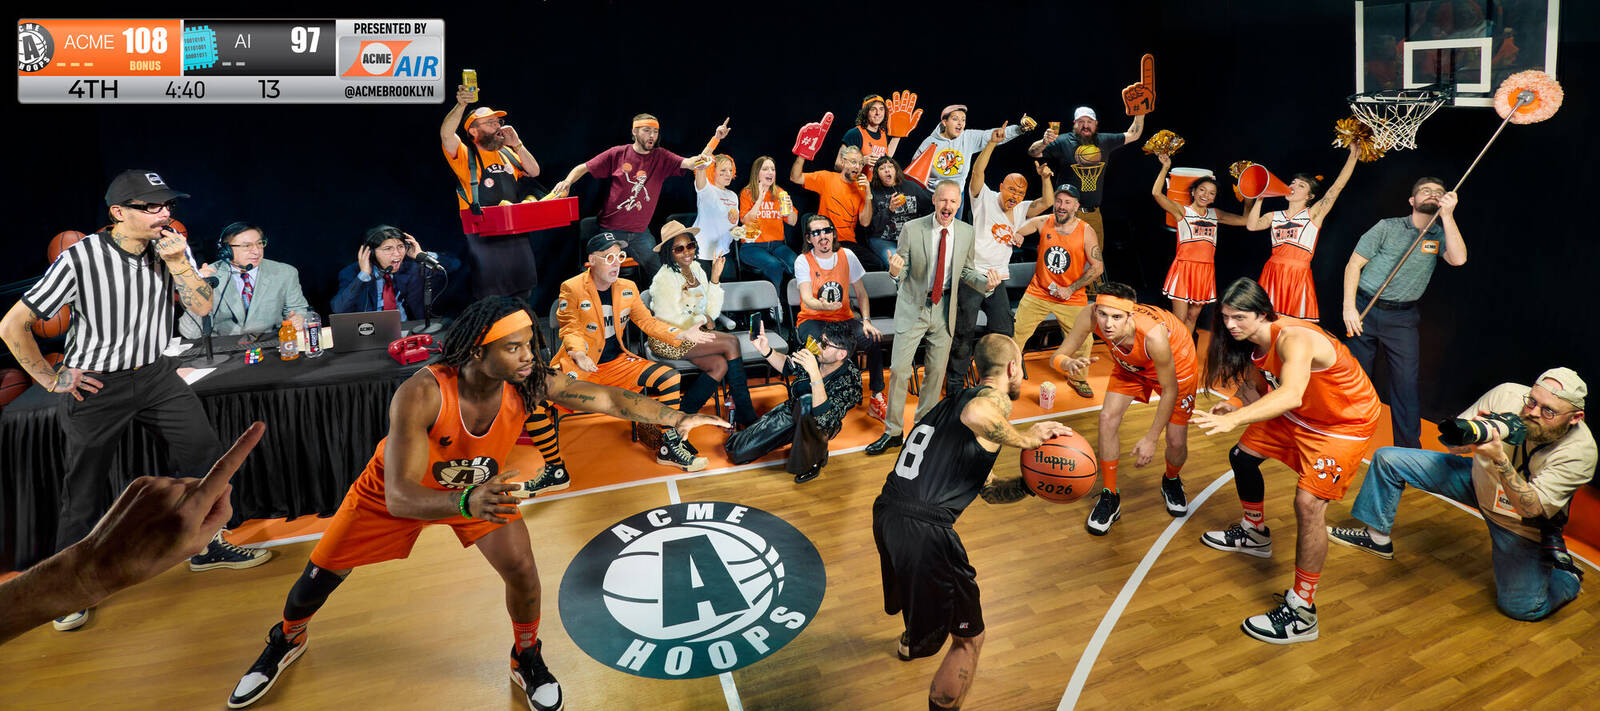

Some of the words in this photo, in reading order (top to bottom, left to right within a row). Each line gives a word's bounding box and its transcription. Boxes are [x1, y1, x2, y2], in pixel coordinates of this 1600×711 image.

[800, 136, 819, 151] #1
[756, 210, 781, 219] PORTS
[895, 424, 935, 480] 8
[1034, 450, 1076, 472] Happy
[449, 456, 491, 467] ACME
[451, 469, 475, 484] A
[1036, 480, 1073, 495] 2026
[610, 503, 749, 544] ACME
[662, 533, 751, 628] A
[616, 606, 806, 676] HOOPS
